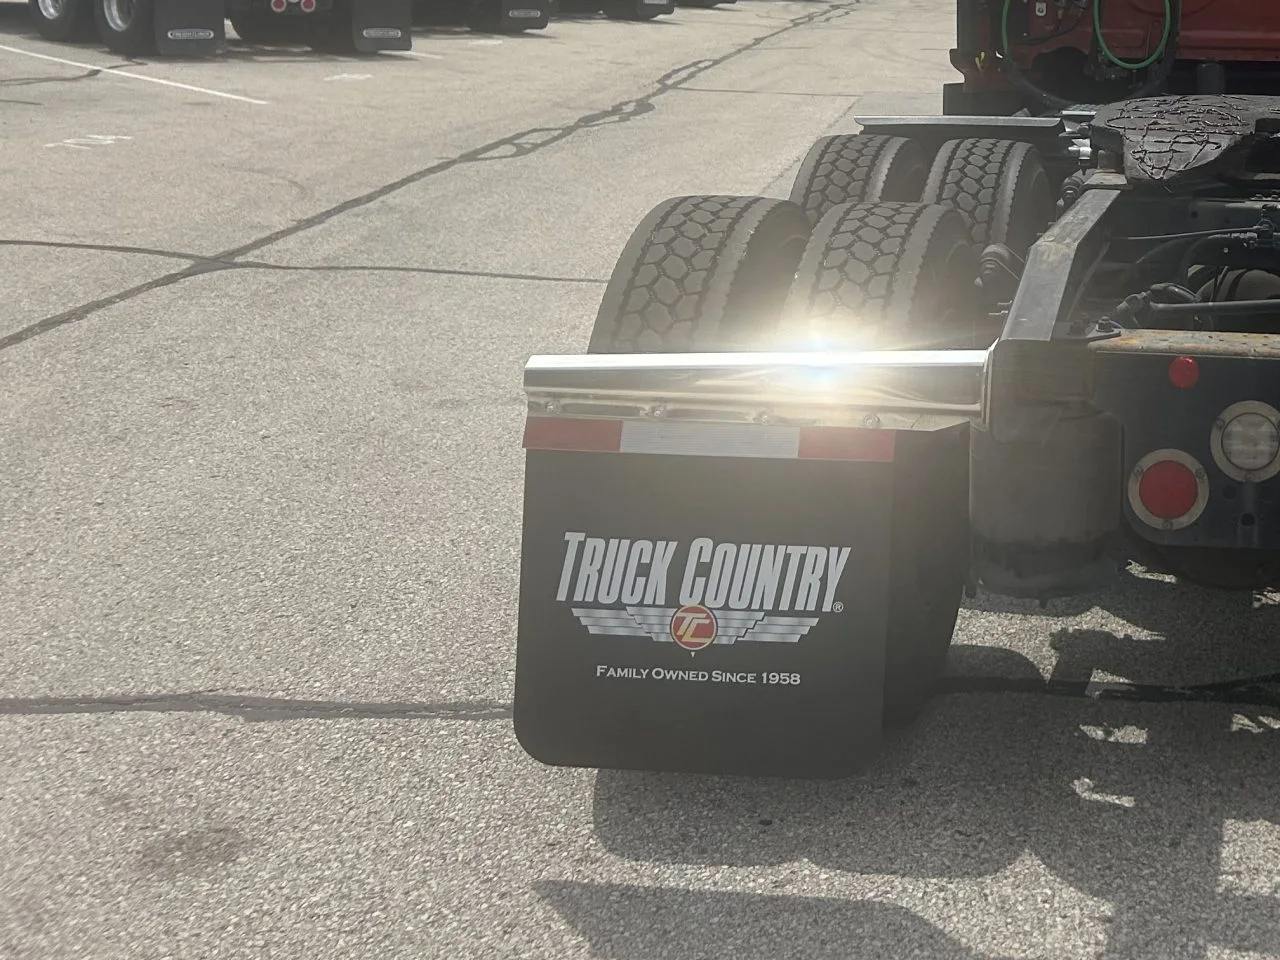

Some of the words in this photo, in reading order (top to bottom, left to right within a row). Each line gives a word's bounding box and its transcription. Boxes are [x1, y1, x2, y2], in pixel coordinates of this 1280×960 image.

[556, 531, 679, 606] TRUCK
[676, 612, 712, 643] TC
[596, 665, 649, 680] FAMILY
[651, 668, 709, 682] OWNED
[711, 670, 757, 684] SINCE
[762, 672, 801, 685] 1958
